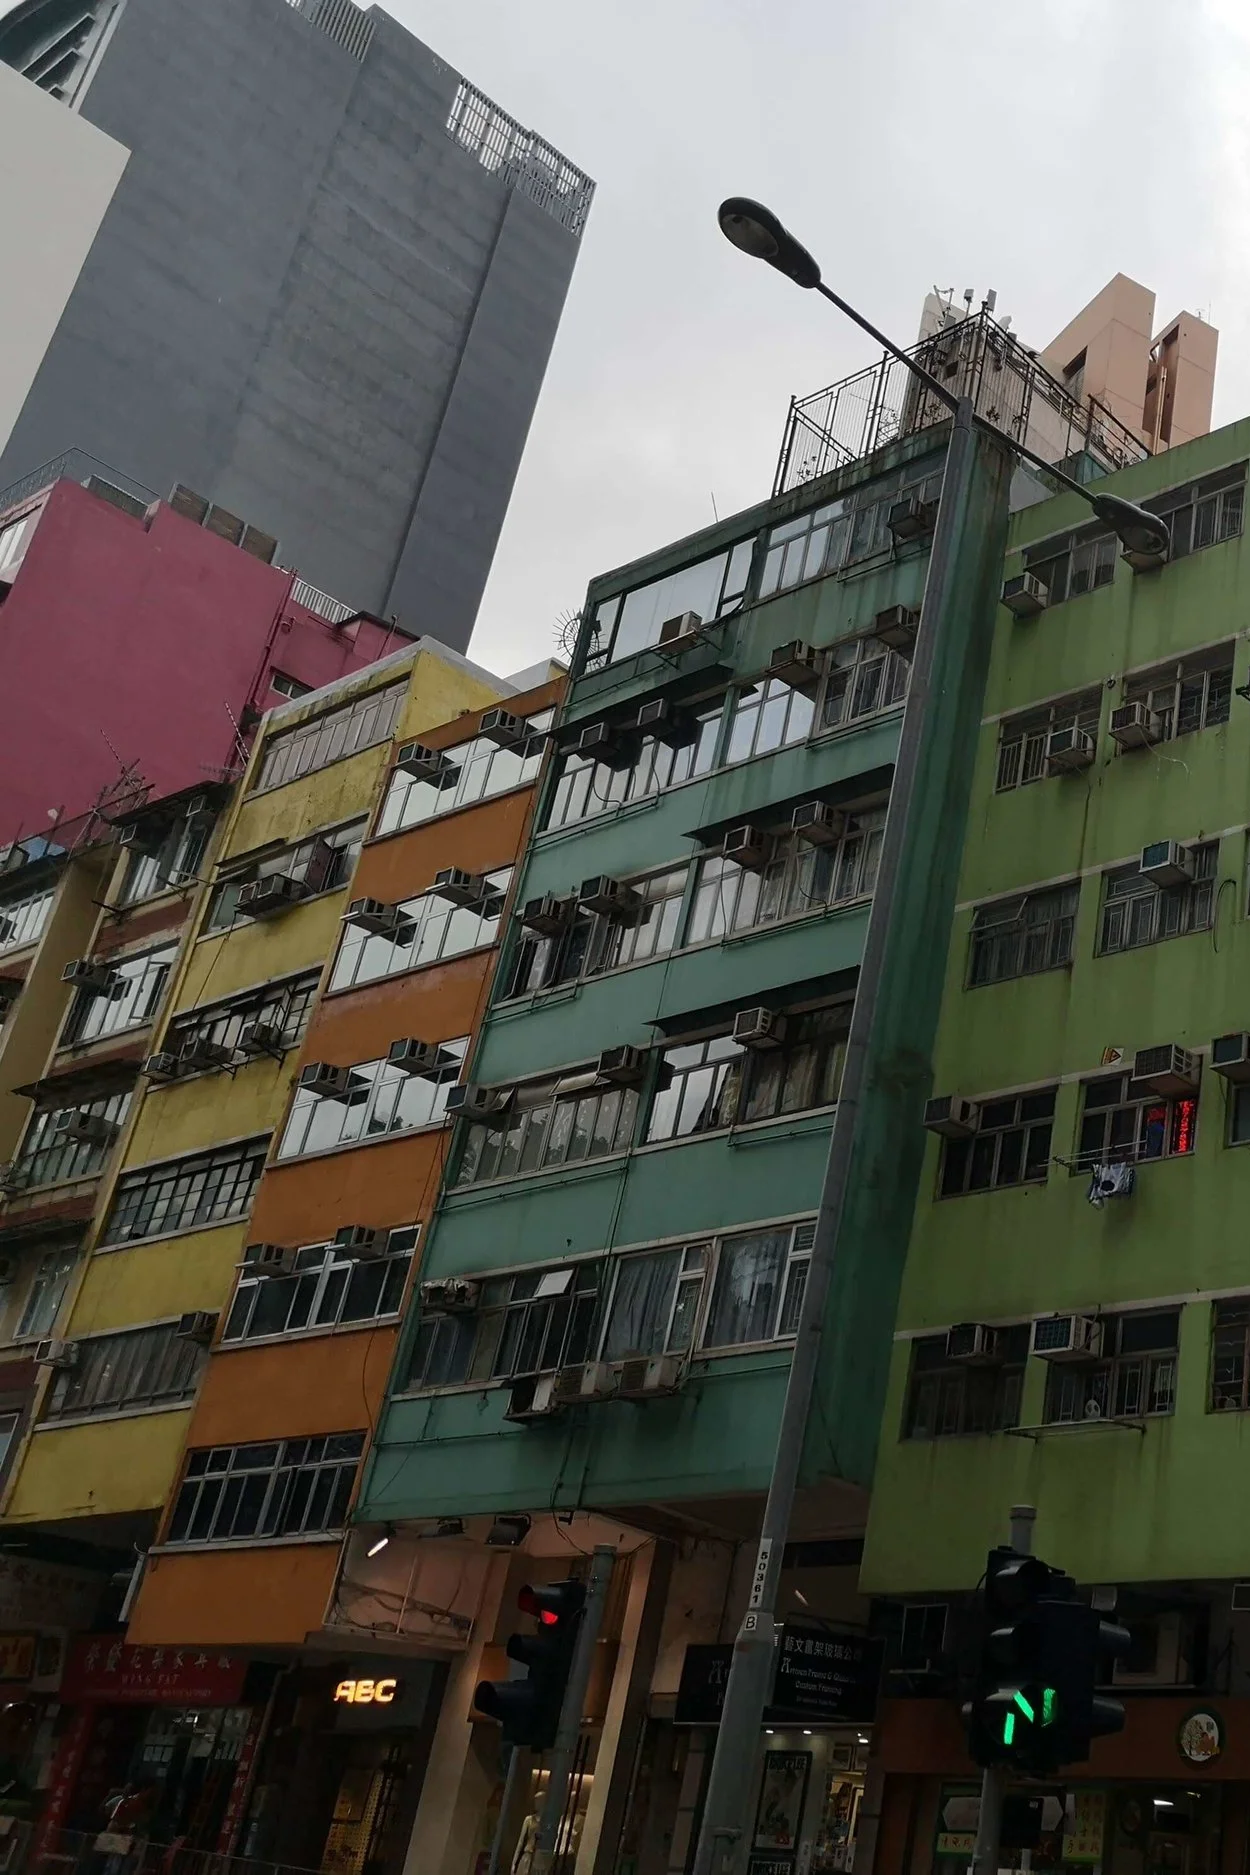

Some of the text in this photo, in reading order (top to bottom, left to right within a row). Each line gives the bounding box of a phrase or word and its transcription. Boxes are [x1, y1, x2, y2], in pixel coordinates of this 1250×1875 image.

[752, 1551, 768, 1603] 50361
[745, 1616, 755, 1629] B
[333, 1679, 397, 1703] ABC
